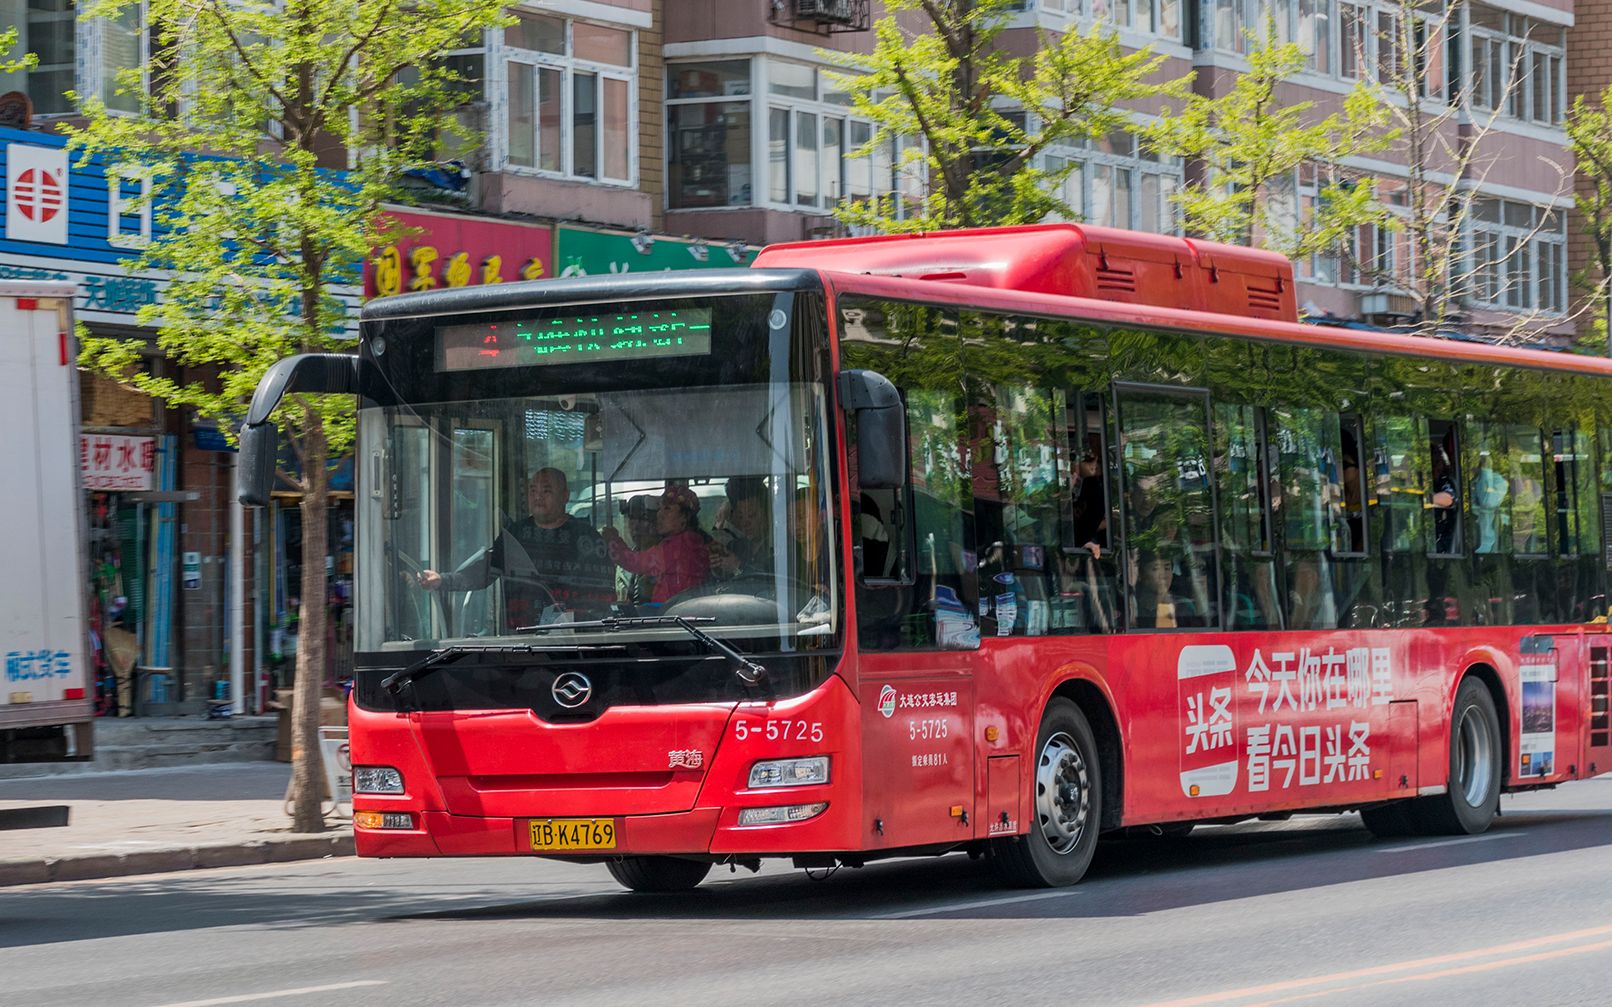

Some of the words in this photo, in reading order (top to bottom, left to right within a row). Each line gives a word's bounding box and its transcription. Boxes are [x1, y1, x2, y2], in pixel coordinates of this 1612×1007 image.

[1245, 646, 1394, 715] 今天你在哪里
[735, 720, 824, 743] 5-5725
[909, 719, 948, 740] 5-5725
[1185, 686, 1233, 755] 头条
[668, 749, 703, 769] 黄海
[1246, 720, 1370, 793] 看今日头条
